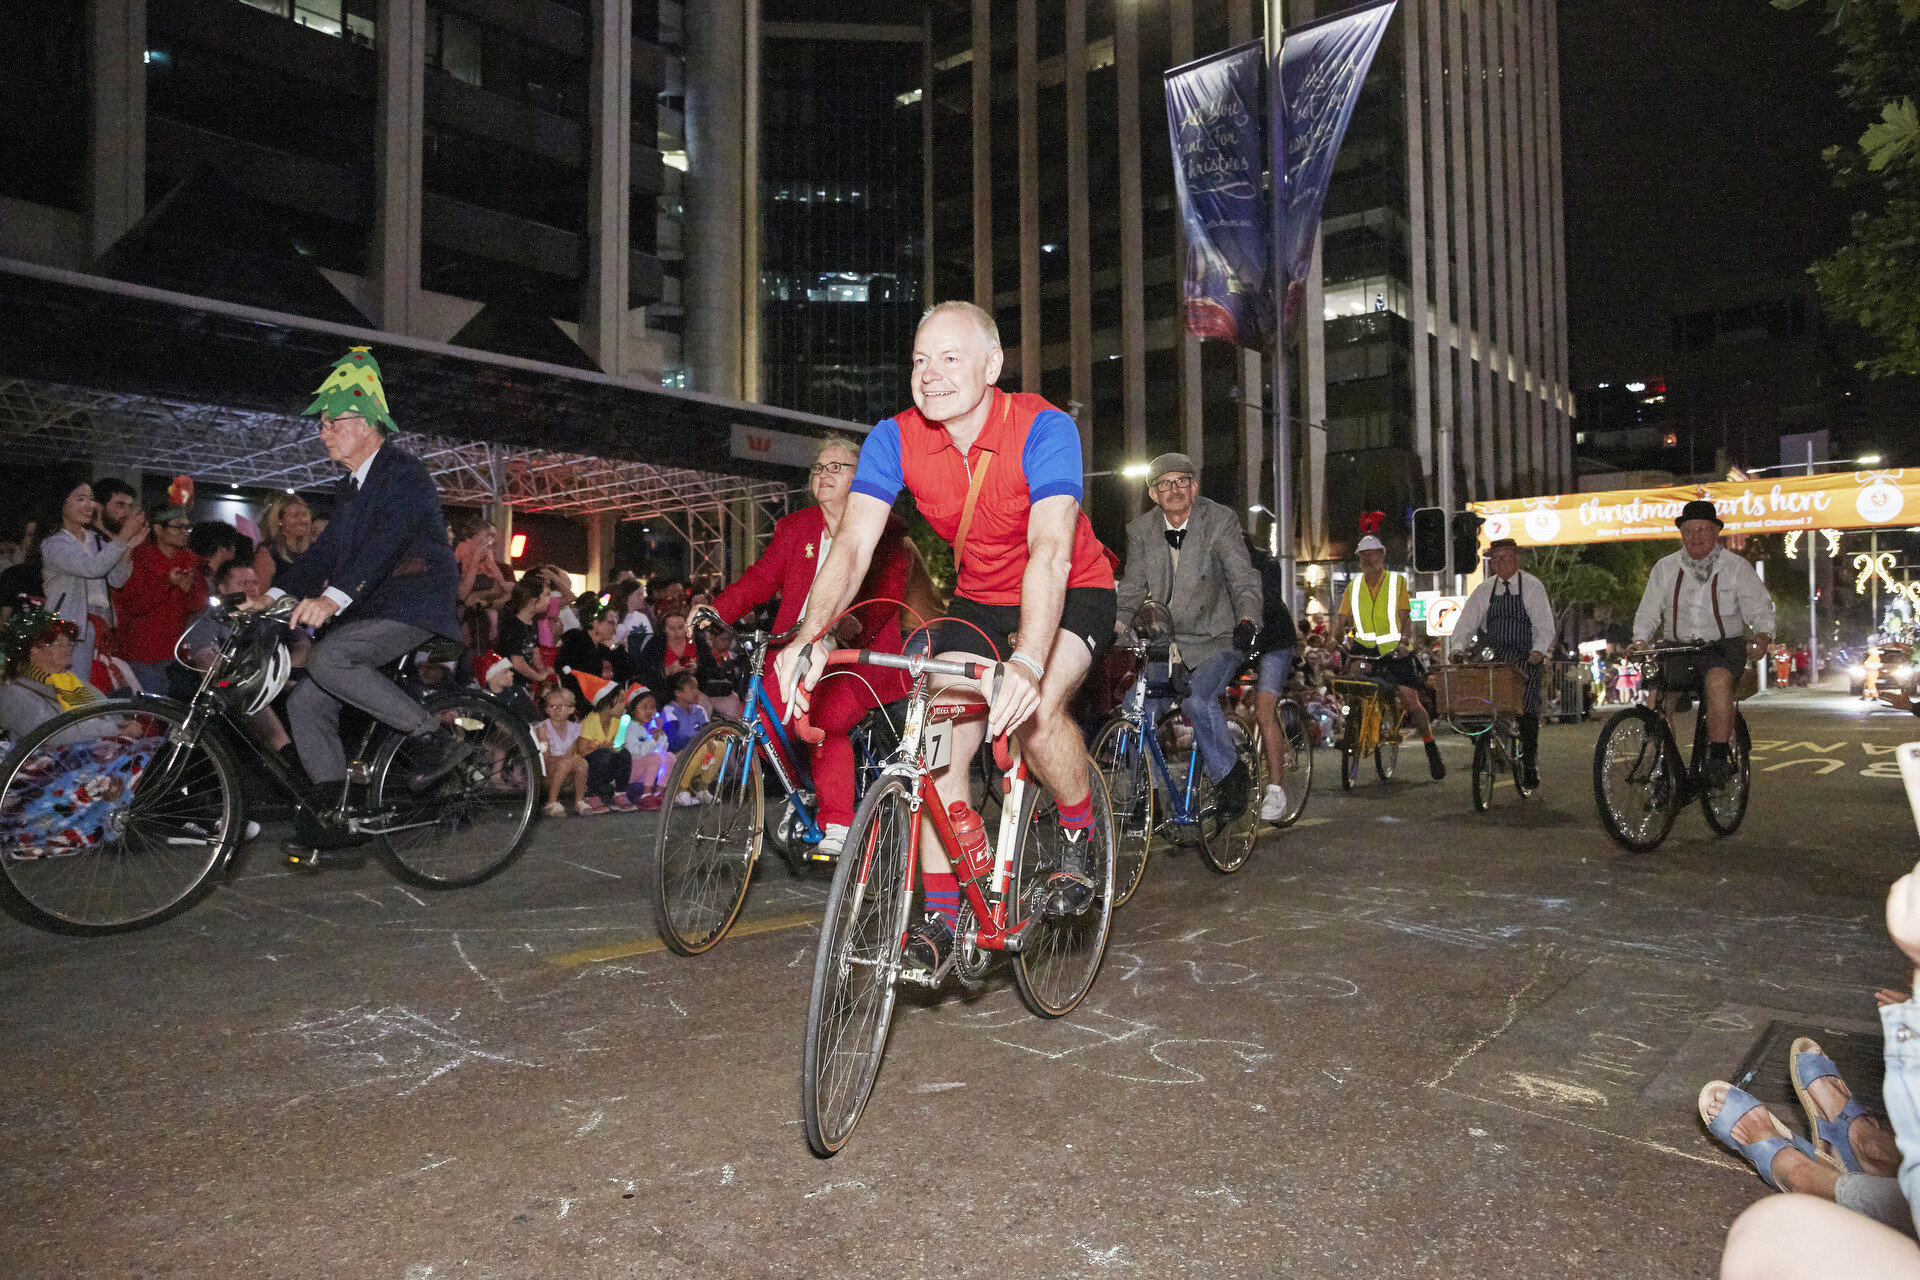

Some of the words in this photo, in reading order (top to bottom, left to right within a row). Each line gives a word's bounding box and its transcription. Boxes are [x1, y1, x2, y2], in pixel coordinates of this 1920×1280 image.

[1183, 153, 1250, 179] hristmas
[1770, 484, 1833, 512] here
[1597, 528, 1620, 536] Merry
[1621, 526, 1663, 535] Christmas
[1743, 519, 1763, 528] and
[1763, 517, 1805, 527] Channel
[1806, 516, 1813, 525] 7
[931, 734, 942, 767] 7
